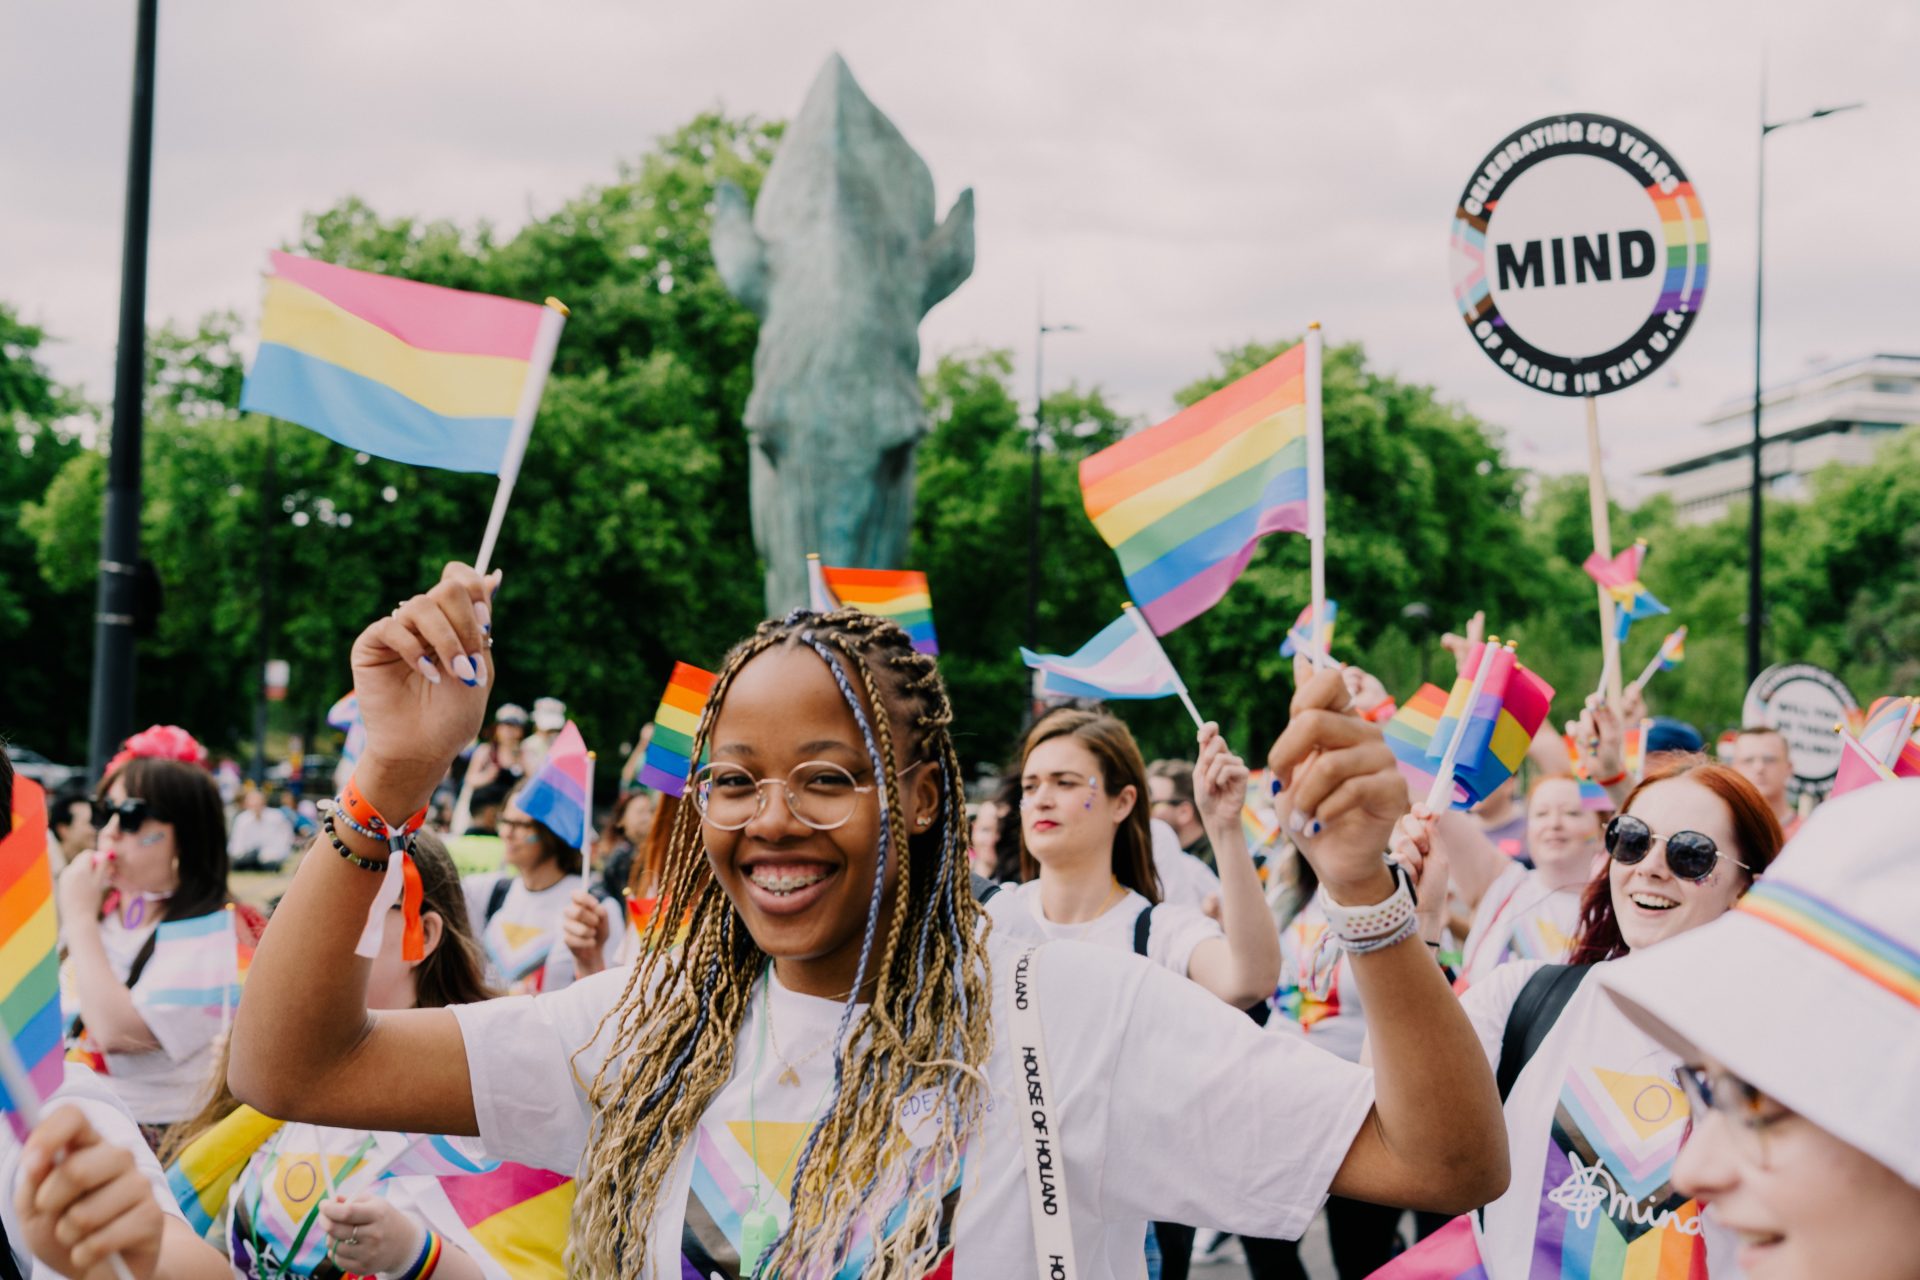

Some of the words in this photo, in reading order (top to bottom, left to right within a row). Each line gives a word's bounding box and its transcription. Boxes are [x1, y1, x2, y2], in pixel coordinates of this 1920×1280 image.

[1464, 121, 1583, 216] CELEBRATING
[1586, 122, 1617, 147] 50
[1618, 132, 1680, 195] YEARS
[1496, 229, 1656, 290] MIND
[1475, 320, 1502, 350] OF
[1500, 348, 1567, 392] PRIDE
[1574, 372, 1601, 393] IN
[1605, 349, 1652, 385] THE
[1022, 1047, 1044, 1106] HOUSE
[1031, 1111, 1048, 1136] OF
[1035, 1138, 1058, 1216] HOLLAND
